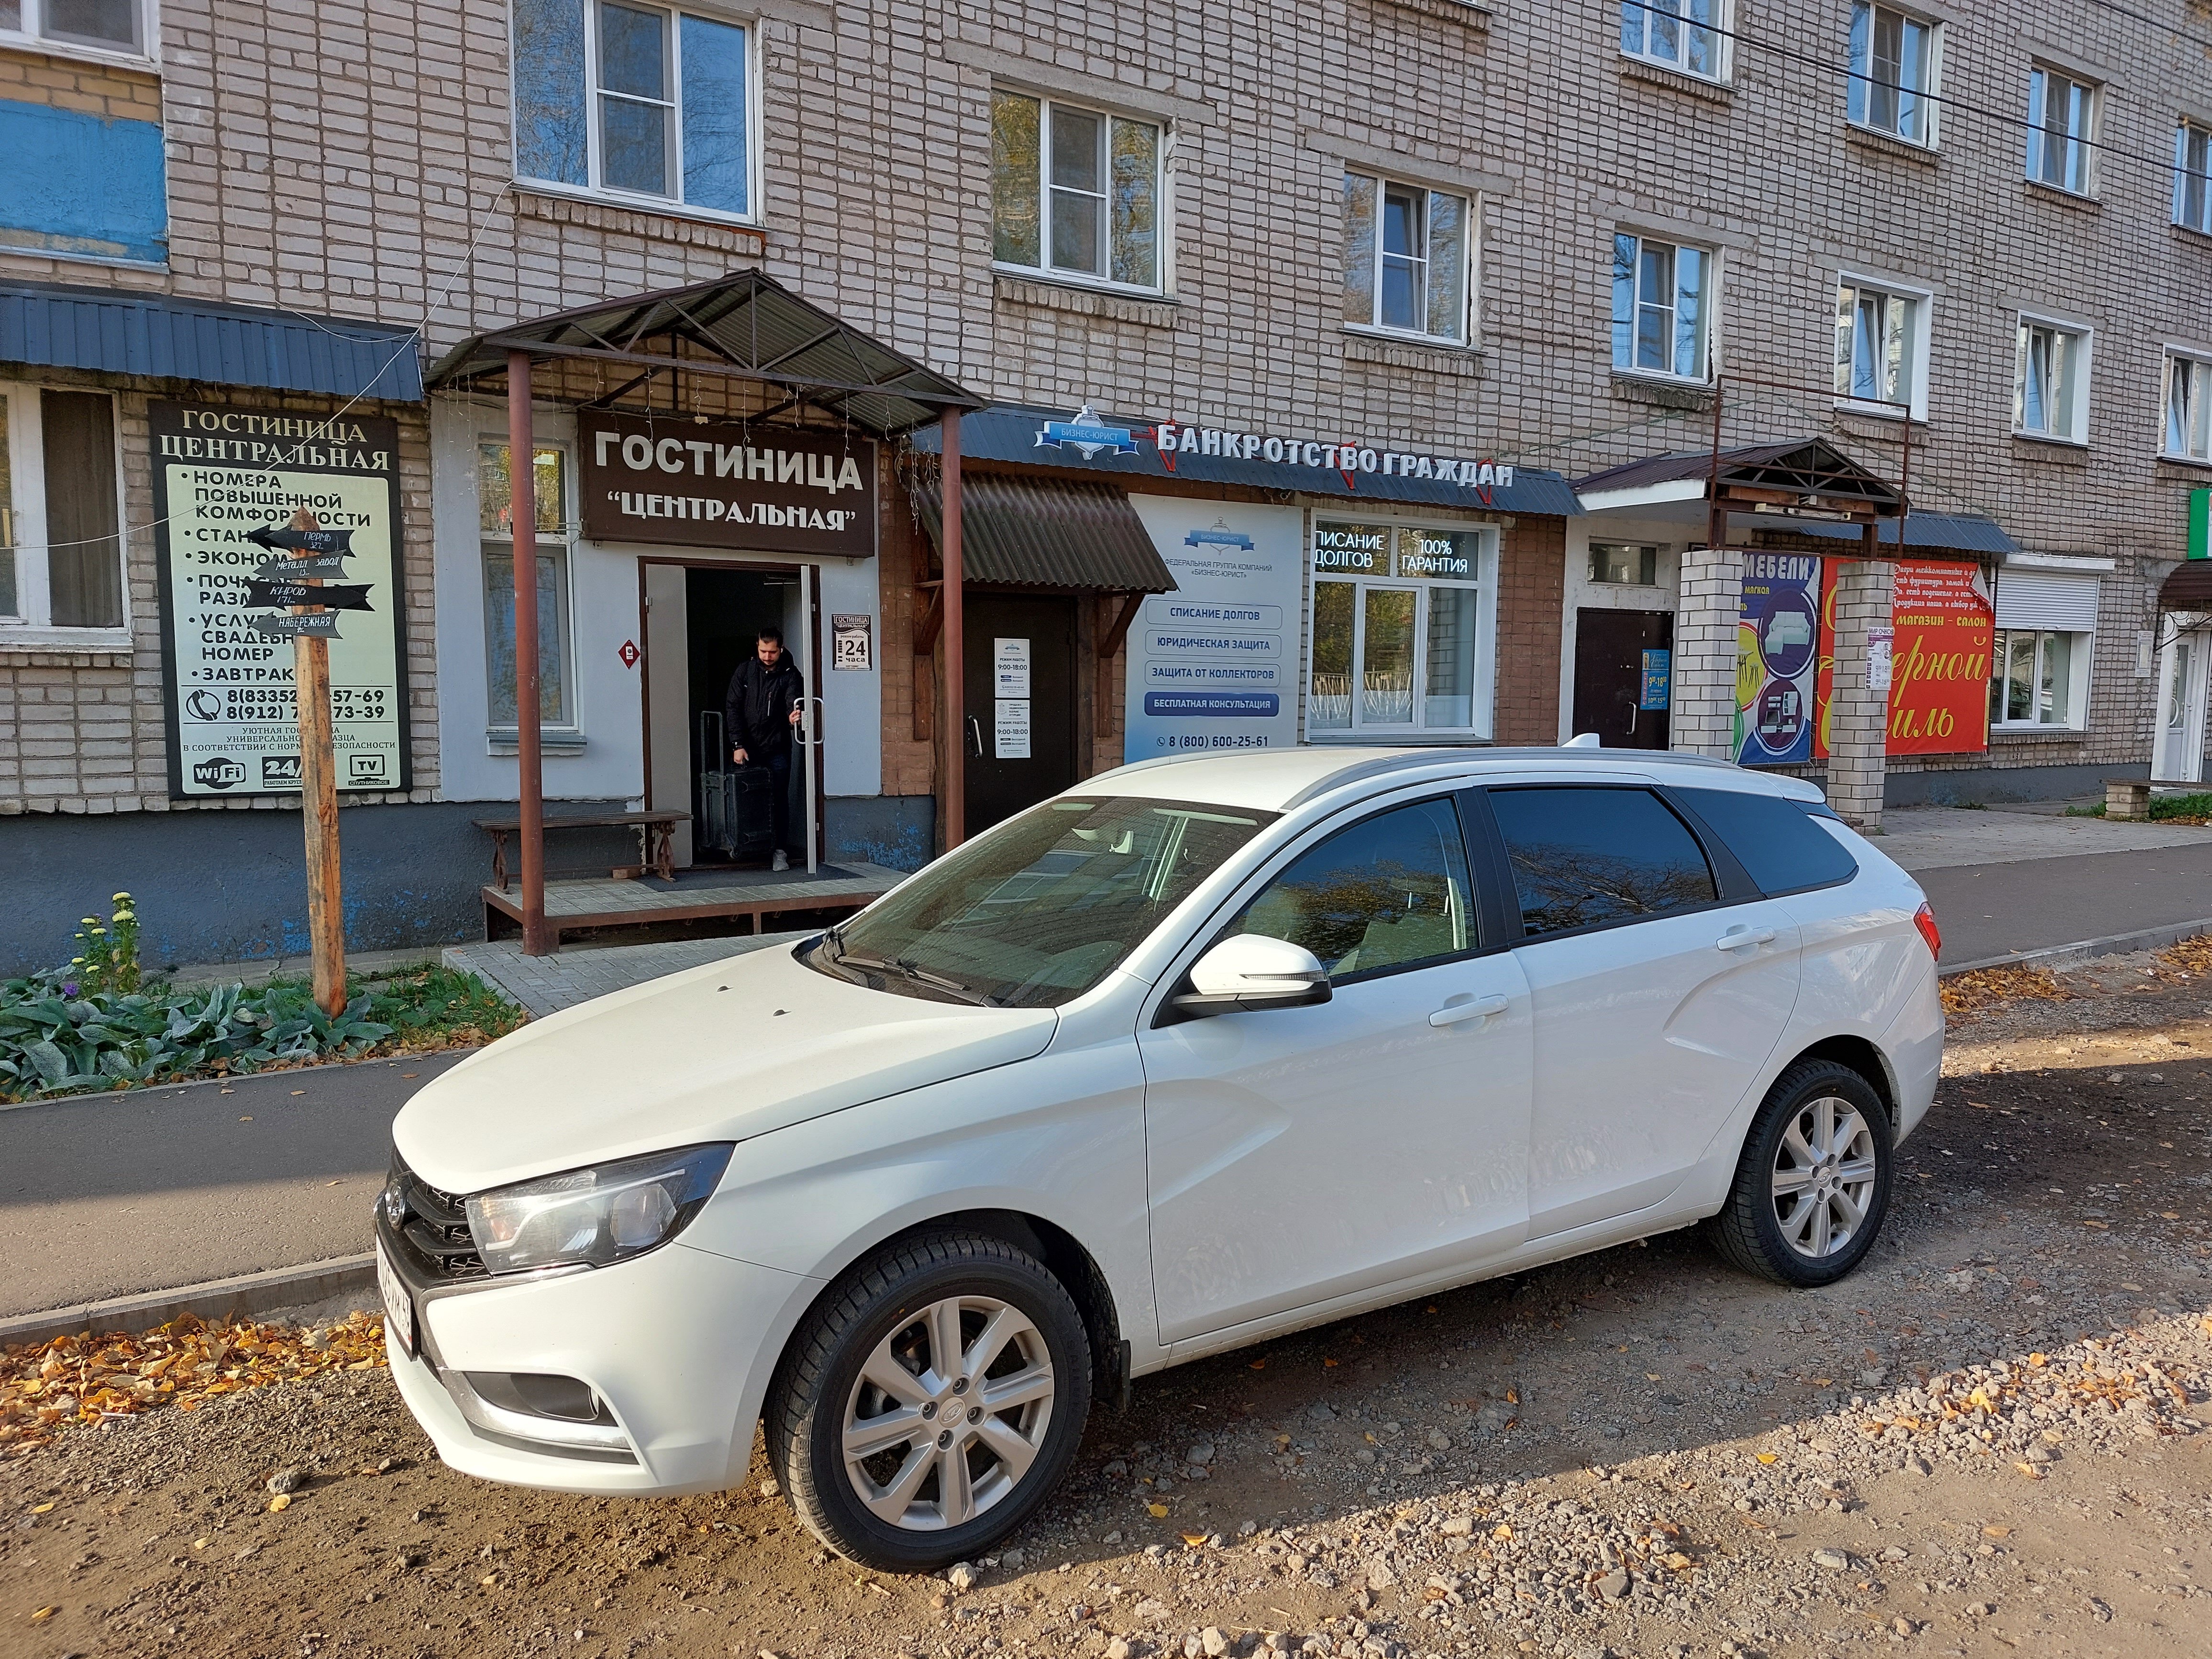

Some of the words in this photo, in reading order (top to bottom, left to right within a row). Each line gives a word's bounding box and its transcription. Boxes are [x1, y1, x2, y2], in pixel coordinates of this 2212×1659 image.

[182, 409, 367, 445] ГОСТИНИЦА
[1061, 428, 1119, 442] БИЗНЕС-ЮРИСТ
[158, 434, 391, 471] ЦЕНТРАЛЬНАЯ
[1158, 424, 1377, 473] БАНКРОТСТВО
[1383, 453, 1514, 488] ГРАЖДАН
[595, 431, 863, 495] ГОСТИНИЦА
[193, 470, 282, 489] НОМЕРА
[195, 487, 342, 509] ПОВЫШЕННОЙ
[608, 490, 856, 532] “ЦЕНТРАЛЬНАЯ”
[196, 529, 255, 544] СТАН
[1200, 534, 1239, 542] БИЗНЕС-ЮРИСТ
[1315, 530, 1385, 550] ПИСАНИЕ
[1419, 539, 1452, 555] 100%
[197, 551, 288, 566] ЭКОНОМ
[1164, 558, 1211, 568] ФЕДЕРАЛЬНАЯ
[1238, 564, 1272, 572] КОМПАНИЙ
[1314, 549, 1373, 567] ДОЛГОВ
[1402, 554, 1468, 573] ГАРАНТИЯ
[1191, 569, 1247, 578] «БИЗНЕС-ЮРИСТ»
[1742, 553, 1809, 580] МЕБЕЛИ
[269, 586, 307, 596] КИРОВ
[200, 613, 277, 629] УСЛУ
[1170, 607, 1220, 619] СПИСАНИЕ
[1223, 610, 1260, 621] ДОЛГОВ
[1896, 615, 1945, 626] магазин
[1956, 616, 1987, 627] салон
[279, 616, 331, 628] НАБЕРЕЖНАЯ
[201, 630, 294, 645] СВАДЕБН
[1157, 637, 1229, 649] ЮРИДИЧЕСКАЯ
[1232, 640, 1271, 651] ЗАЩИТА
[202, 647, 274, 661] НОМЕР
[845, 640, 866, 656] 24
[202, 667, 295, 681] ЗАВТРАК
[1152, 667, 1193, 678] ЗАЩИТА
[1195, 668, 1207, 678] ОТ
[1209, 669, 1274, 679] КОЛЛЕКТОРОВ
[227, 688, 297, 704] 8(83352
[1154, 699, 1207, 708] БЕСПЛАТНАЯ
[1208, 699, 1271, 710] КОНСУЛЬТАЦИЯ
[227, 705, 284, 719] 8(912)
[242, 727, 282, 735] УЮТНАЯ
[226, 735, 300, 743] УНИВЕРСАЛЬНО
[332, 734, 356, 743] АЗЦА
[1169, 736, 1175, 747] 8
[1179, 735, 1209, 749] (800)
[1212, 735, 1269, 747] 600-25-61
[192, 743, 266, 752] СООТВЕТСТВИИ
[332, 741, 396, 750] ЕЗОПАСНОСТИ
[265, 760, 302, 776] 24/
[357, 760, 377, 771] TV
